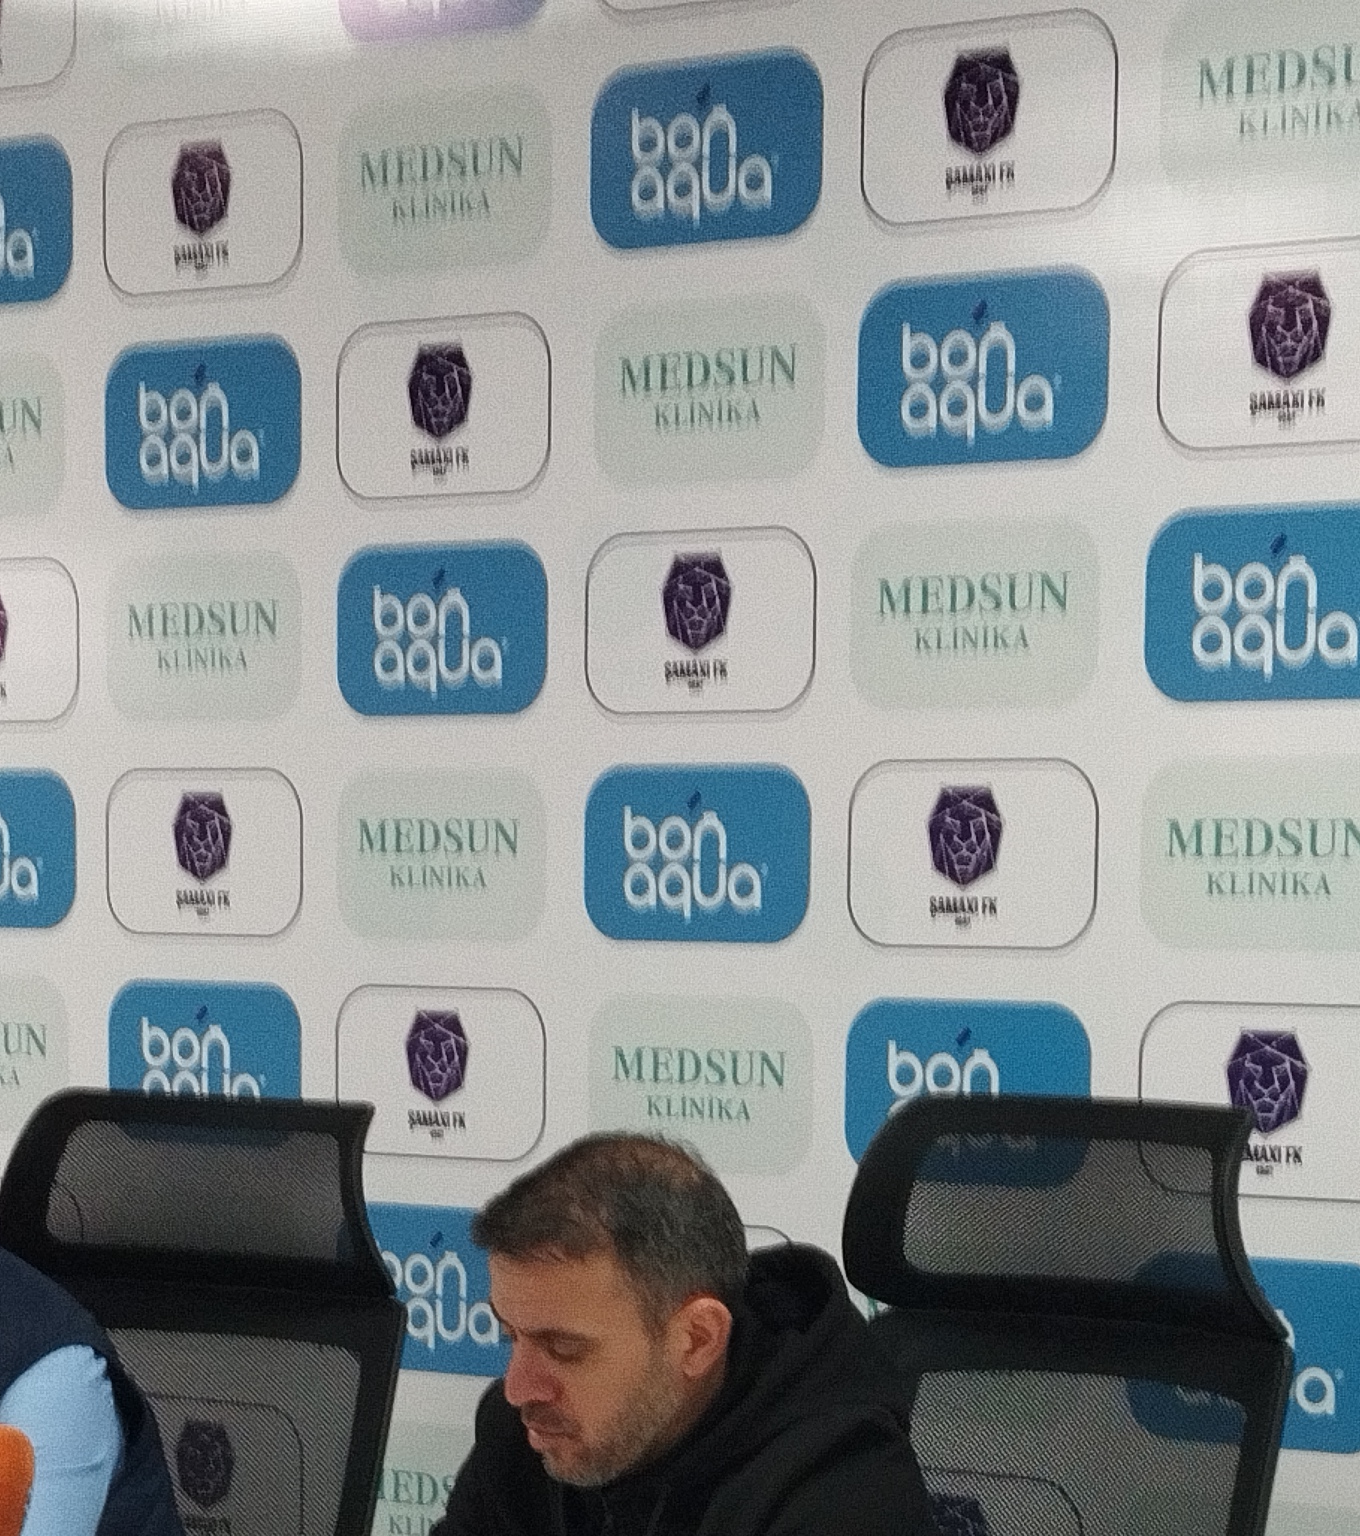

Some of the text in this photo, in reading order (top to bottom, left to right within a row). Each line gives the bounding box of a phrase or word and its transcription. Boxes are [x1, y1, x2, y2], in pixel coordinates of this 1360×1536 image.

[357, 134, 527, 189] MEDSUN
[629, 105, 737, 165] bon
[628, 155, 774, 219] aqua
[617, 343, 801, 394] MEDSUN
[899, 322, 1016, 381] bon
[137, 382, 229, 434] bon
[898, 375, 1056, 439] aqua
[137, 429, 260, 486] aqua
[874, 569, 1073, 616] MEDSUN
[1191, 553, 1318, 613] bon
[125, 598, 281, 638] MEDSUN
[372, 585, 470, 639] bon
[371, 637, 504, 693] aqua
[1190, 611, 1360, 675] aqua
[355, 817, 522, 855] MEDSUN
[621, 805, 728, 861] bon
[621, 862, 764, 918] aqua
[140, 1015, 231, 1069] bon
[609, 1044, 790, 1089] MEDSUN
[885, 1038, 1000, 1094] bon
[406, 1297, 501, 1350] qua
